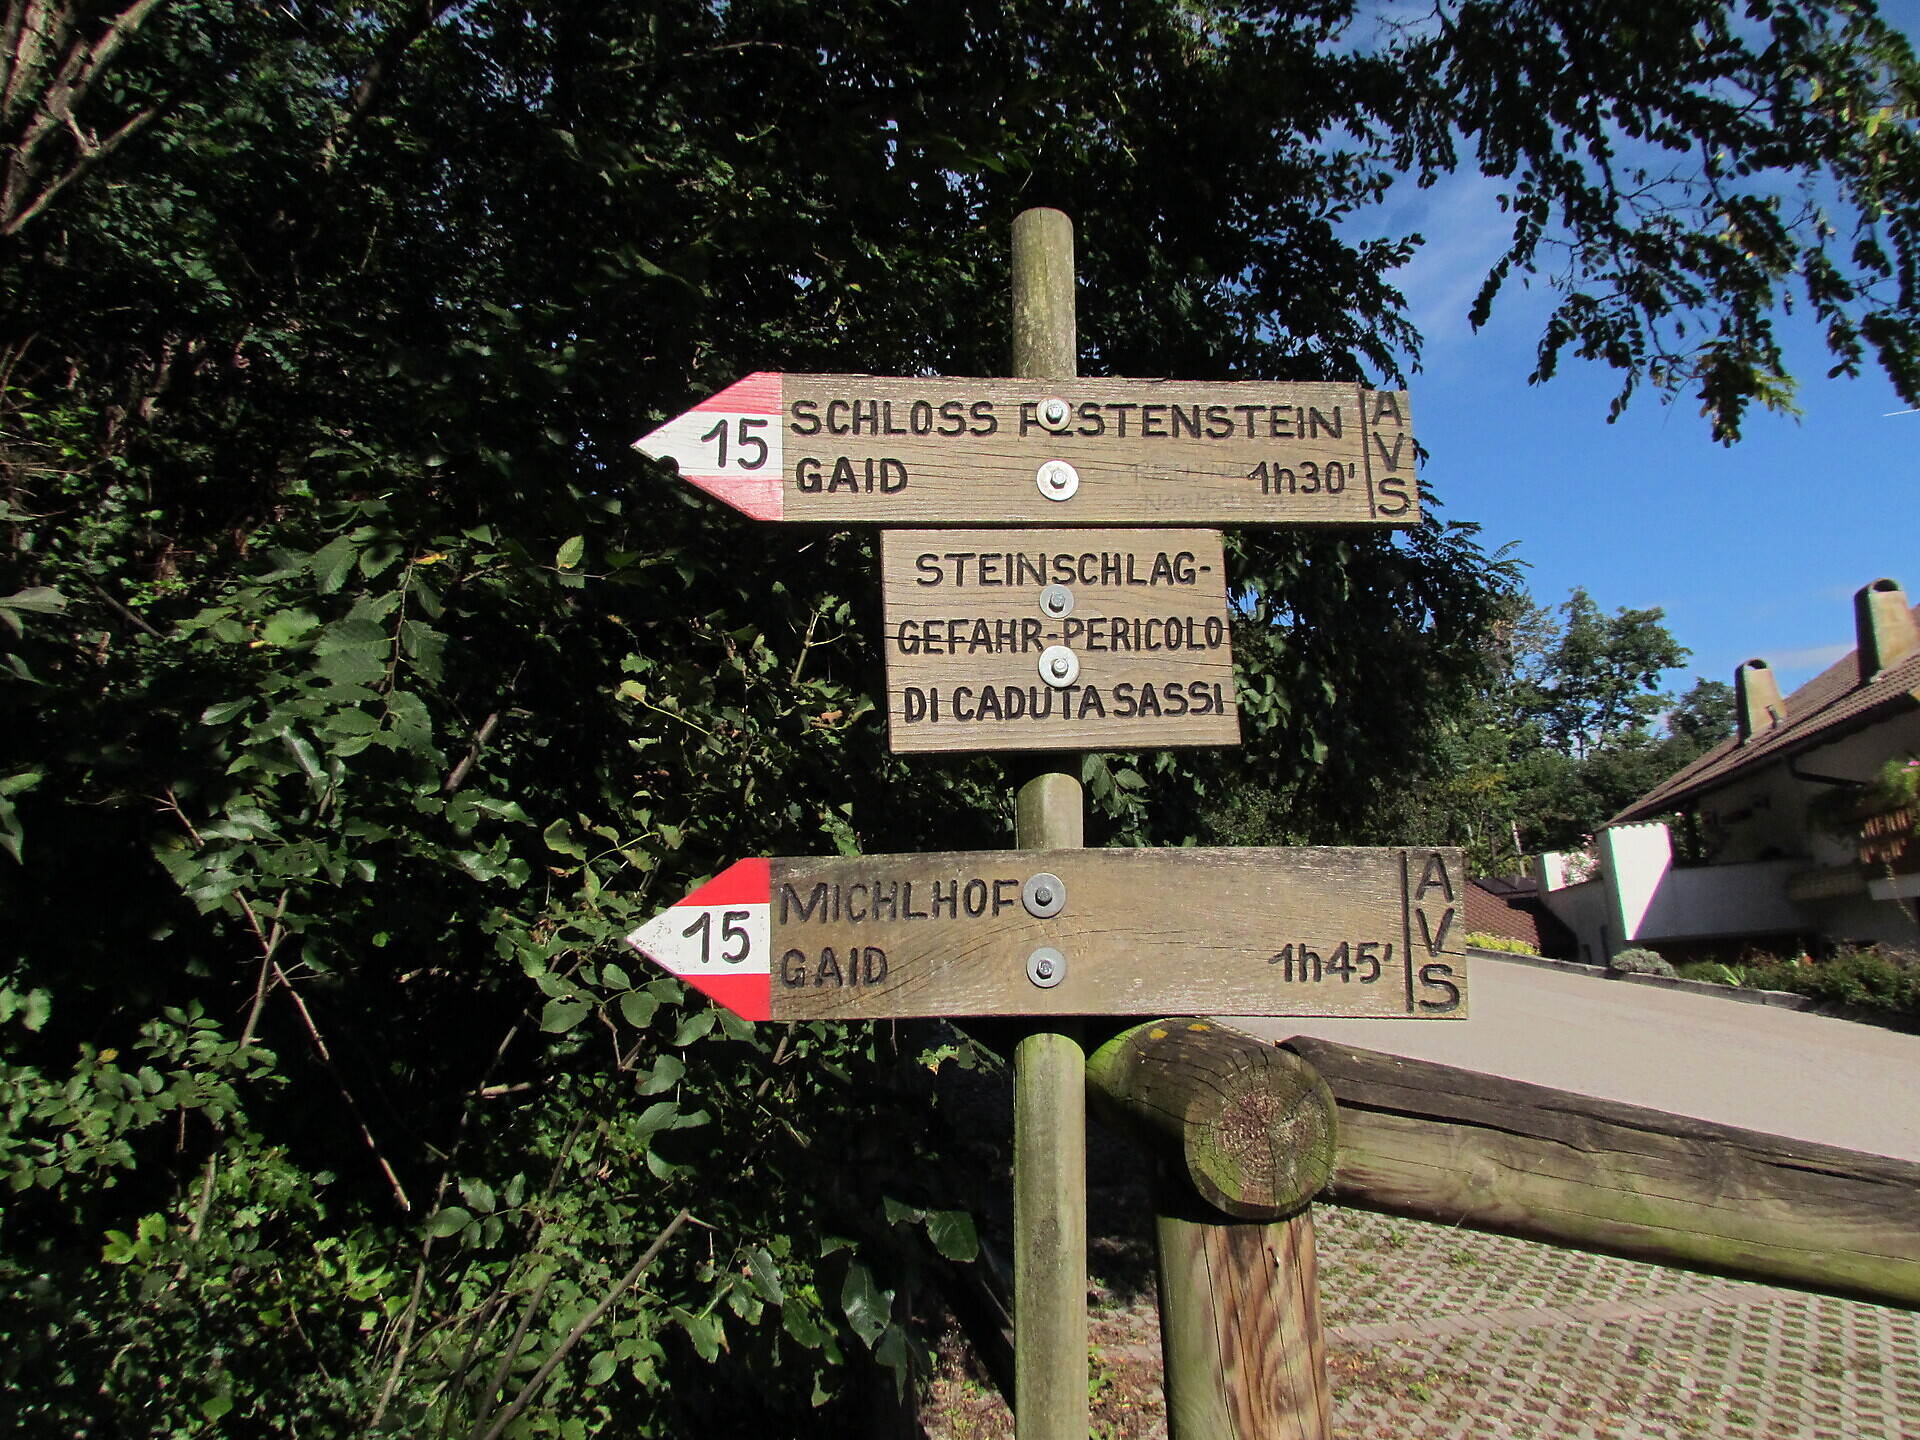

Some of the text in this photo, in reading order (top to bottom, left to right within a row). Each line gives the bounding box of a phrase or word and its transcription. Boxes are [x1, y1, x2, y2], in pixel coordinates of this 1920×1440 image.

[790, 399, 999, 437] SCHLOSS
[701, 418, 768, 470] 15
[796, 456, 909, 494] GAID
[915, 552, 1212, 587] STEINSCHLAG-
[904, 680, 1225, 723] DI CADUTA SASSI
[779, 877, 1020, 925] MICHLHOF
[681, 910, 752, 964] 15
[779, 945, 889, 989] GAID
